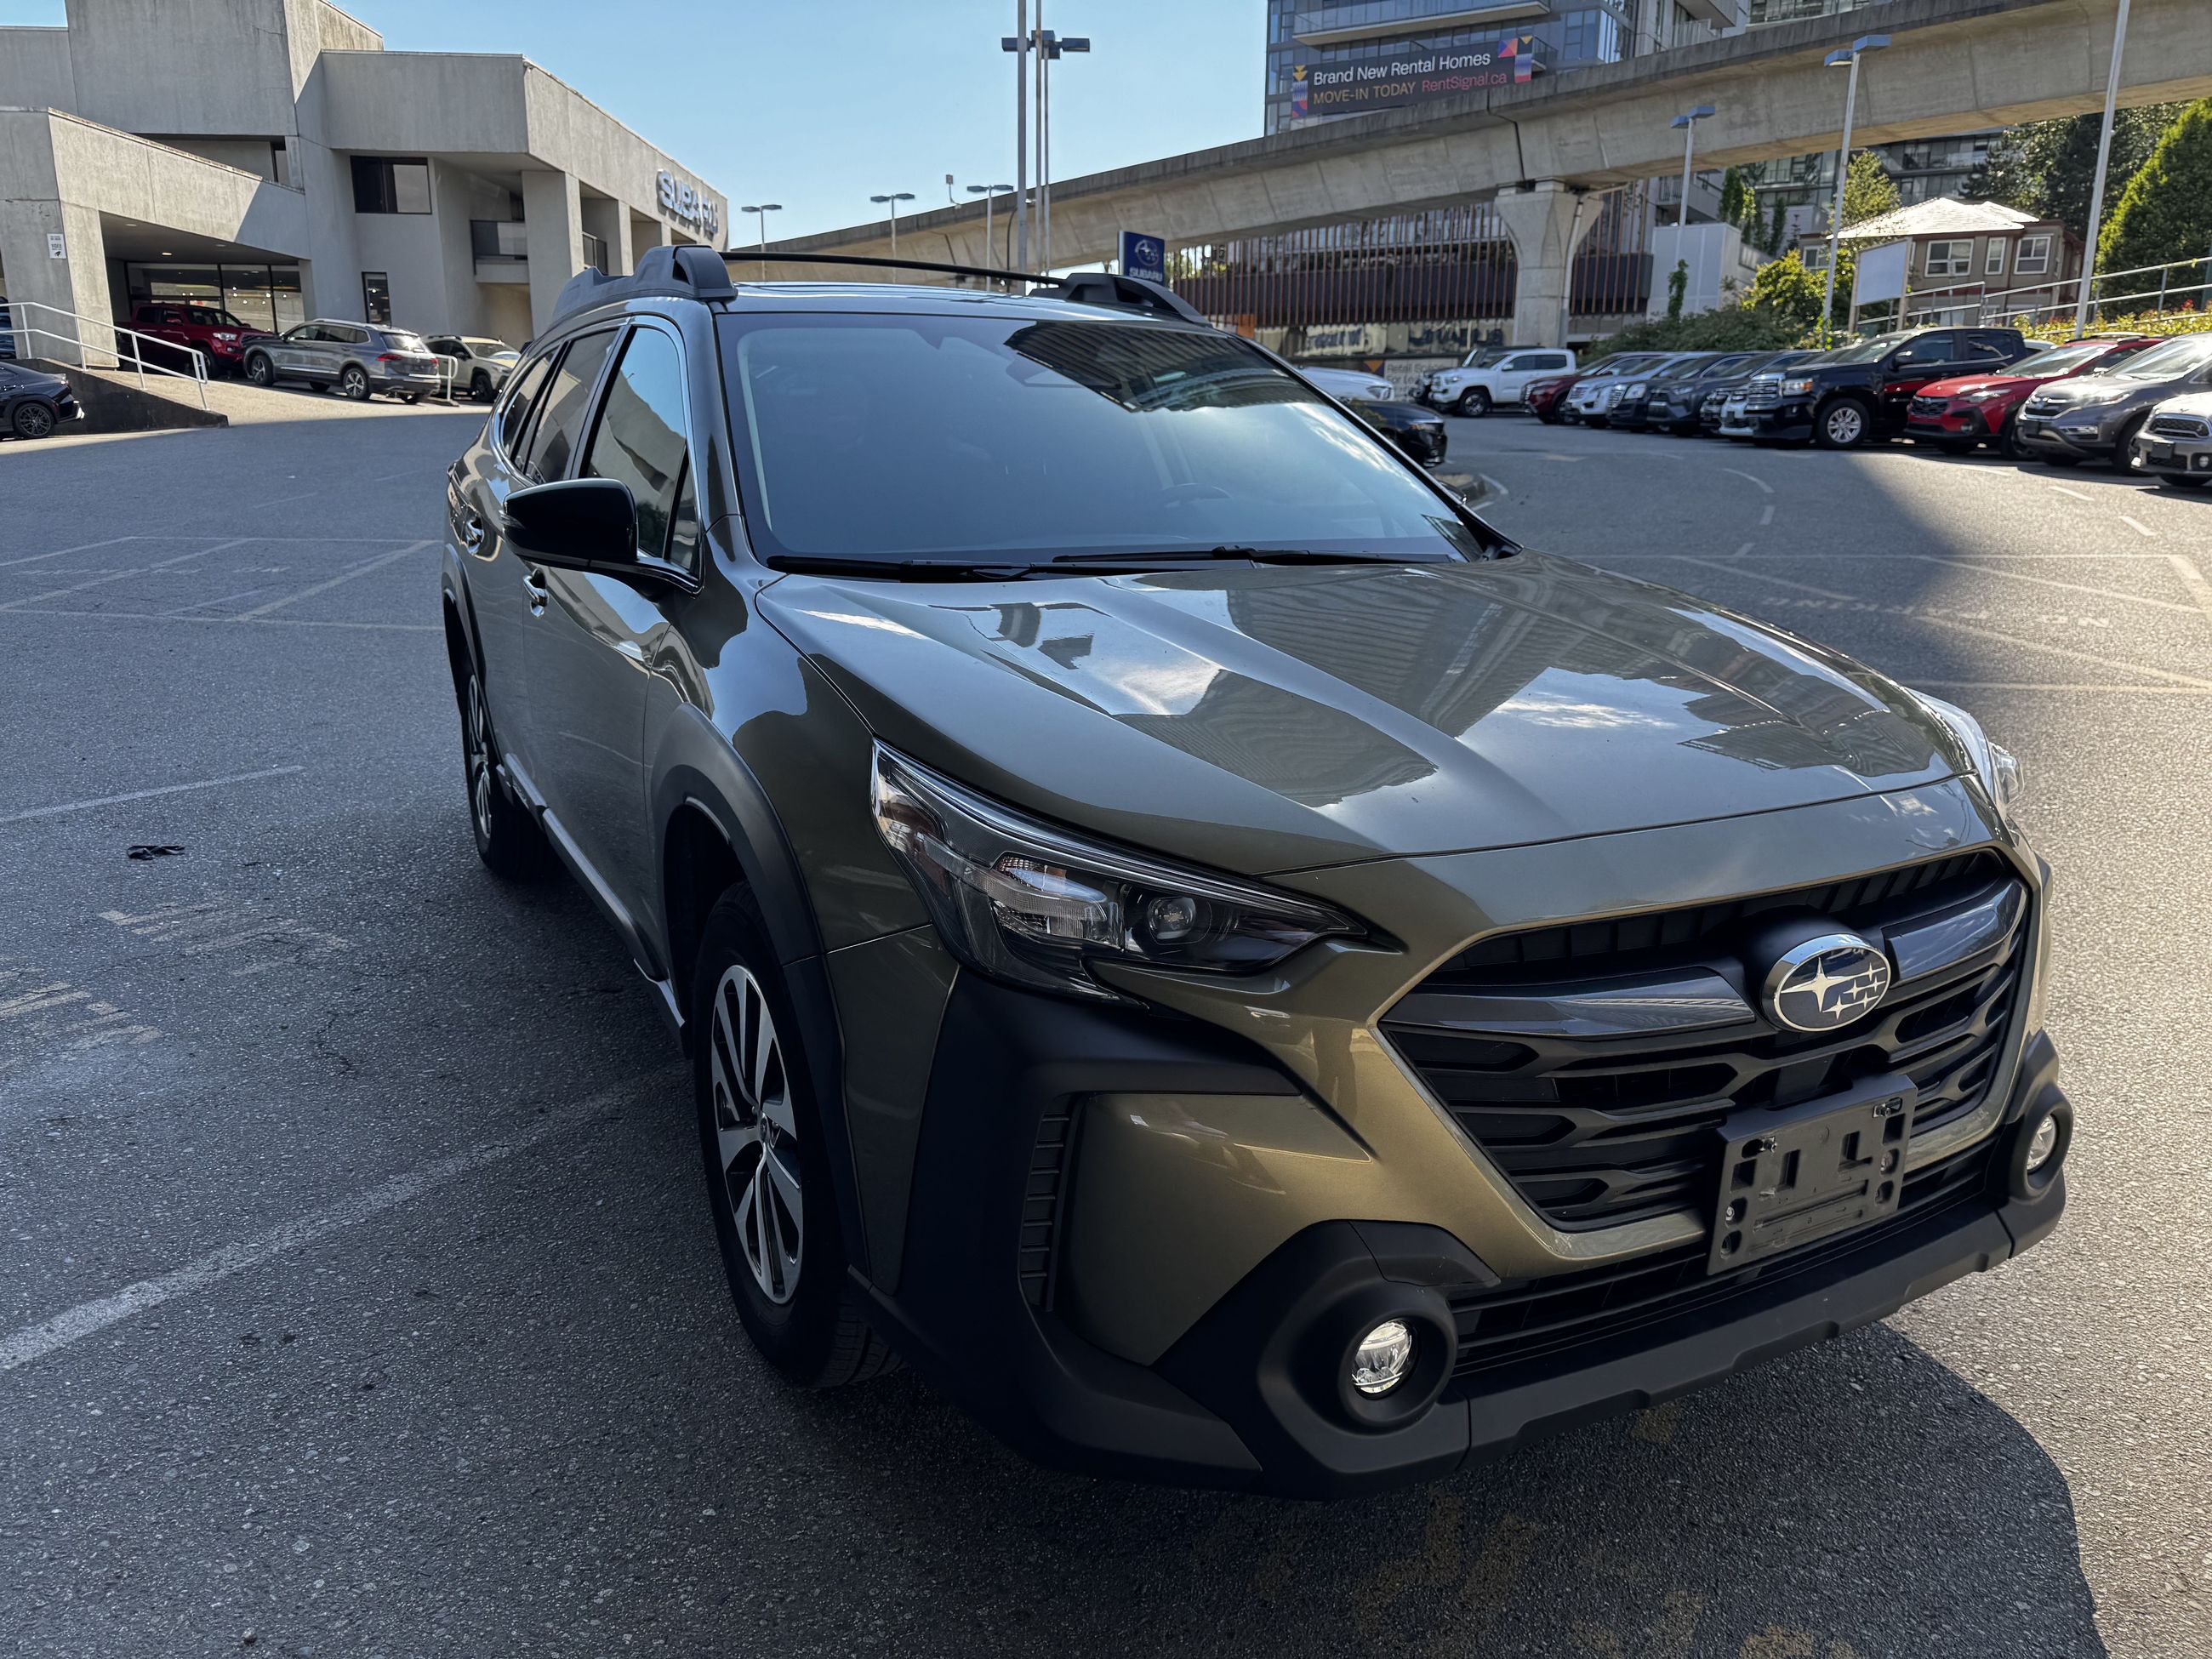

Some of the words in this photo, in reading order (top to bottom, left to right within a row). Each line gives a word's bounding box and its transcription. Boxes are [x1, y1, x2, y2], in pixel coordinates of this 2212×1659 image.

[1314, 66, 1354, 85] Brand
[1357, 66, 1388, 81] New
[1391, 56, 1435, 77] Rental
[1440, 53, 1491, 70] Homes
[1314, 88, 1369, 105] MOVE-IN
[1373, 82, 1417, 99] TODAY
[1422, 71, 1508, 92] RentSignal.ca
